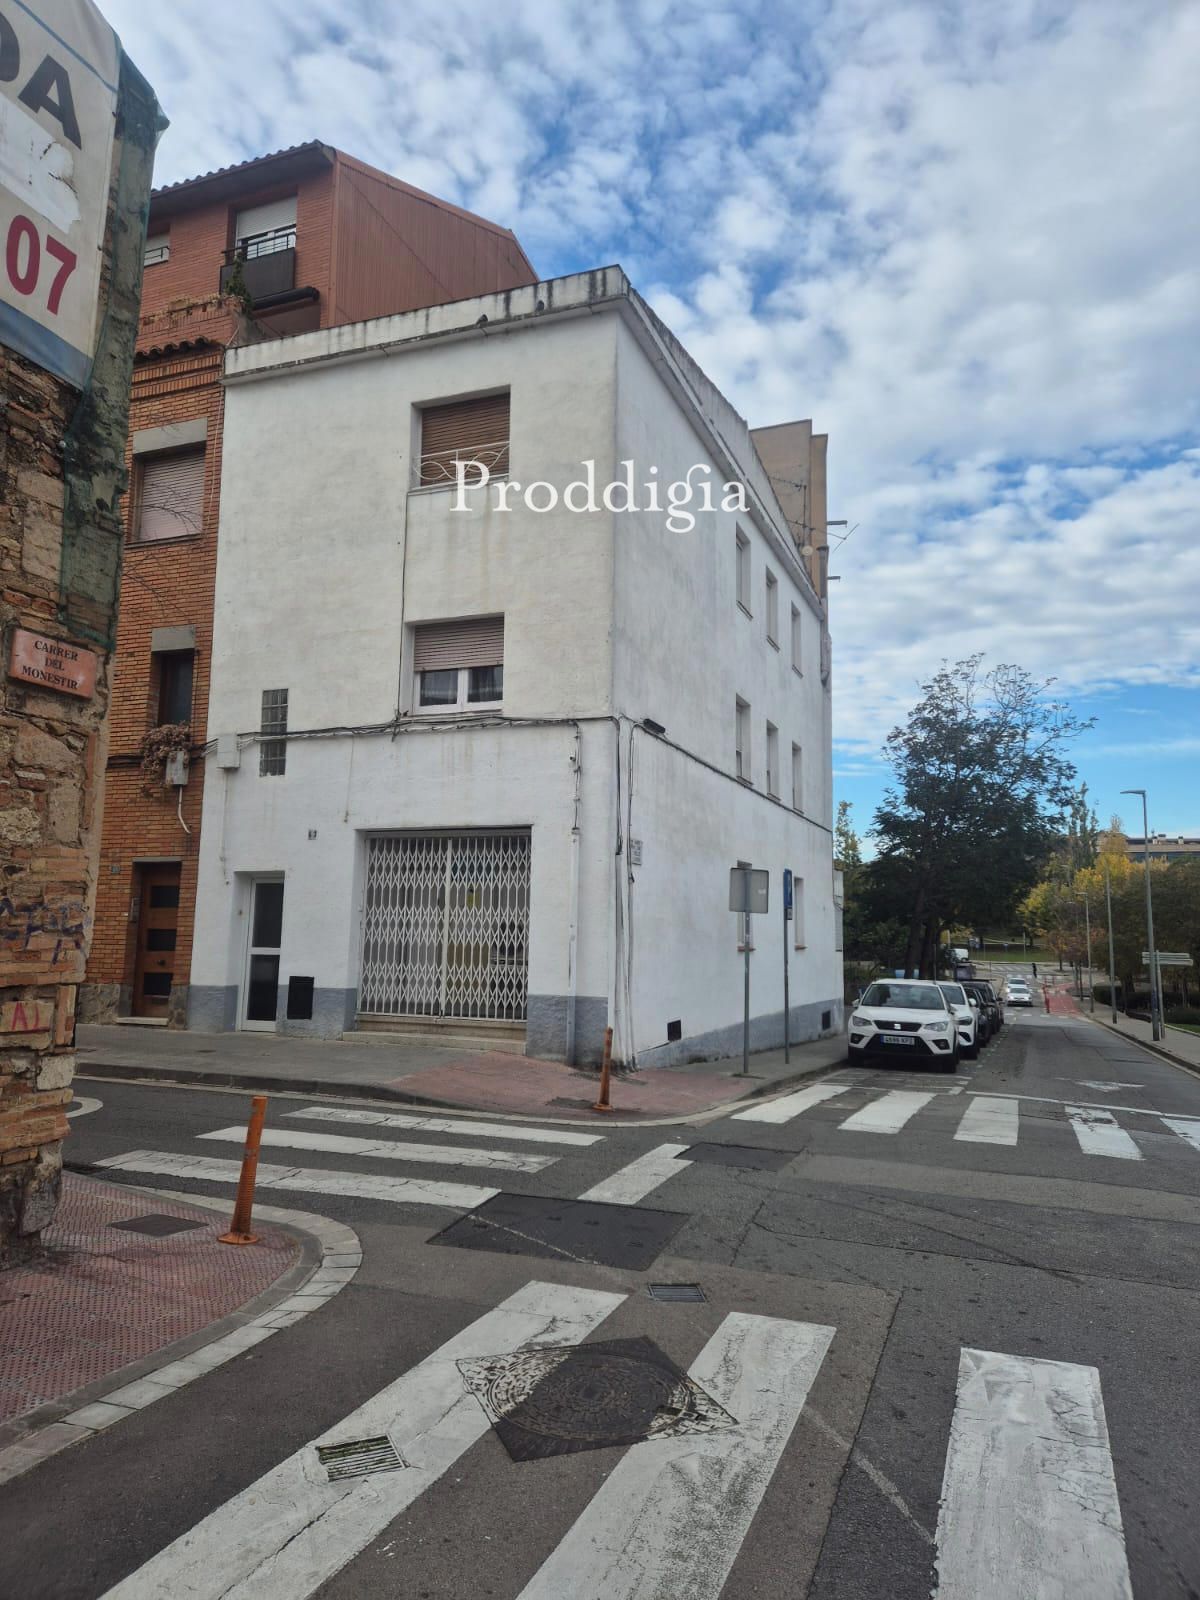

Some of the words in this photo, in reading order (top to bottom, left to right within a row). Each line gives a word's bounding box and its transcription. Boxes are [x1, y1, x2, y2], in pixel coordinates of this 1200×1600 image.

[6, 214, 78, 316] 07
[34, 640, 79, 661] CARRER
[44, 656, 65, 671] DEL
[22, 665, 78, 690] MONESTIR
